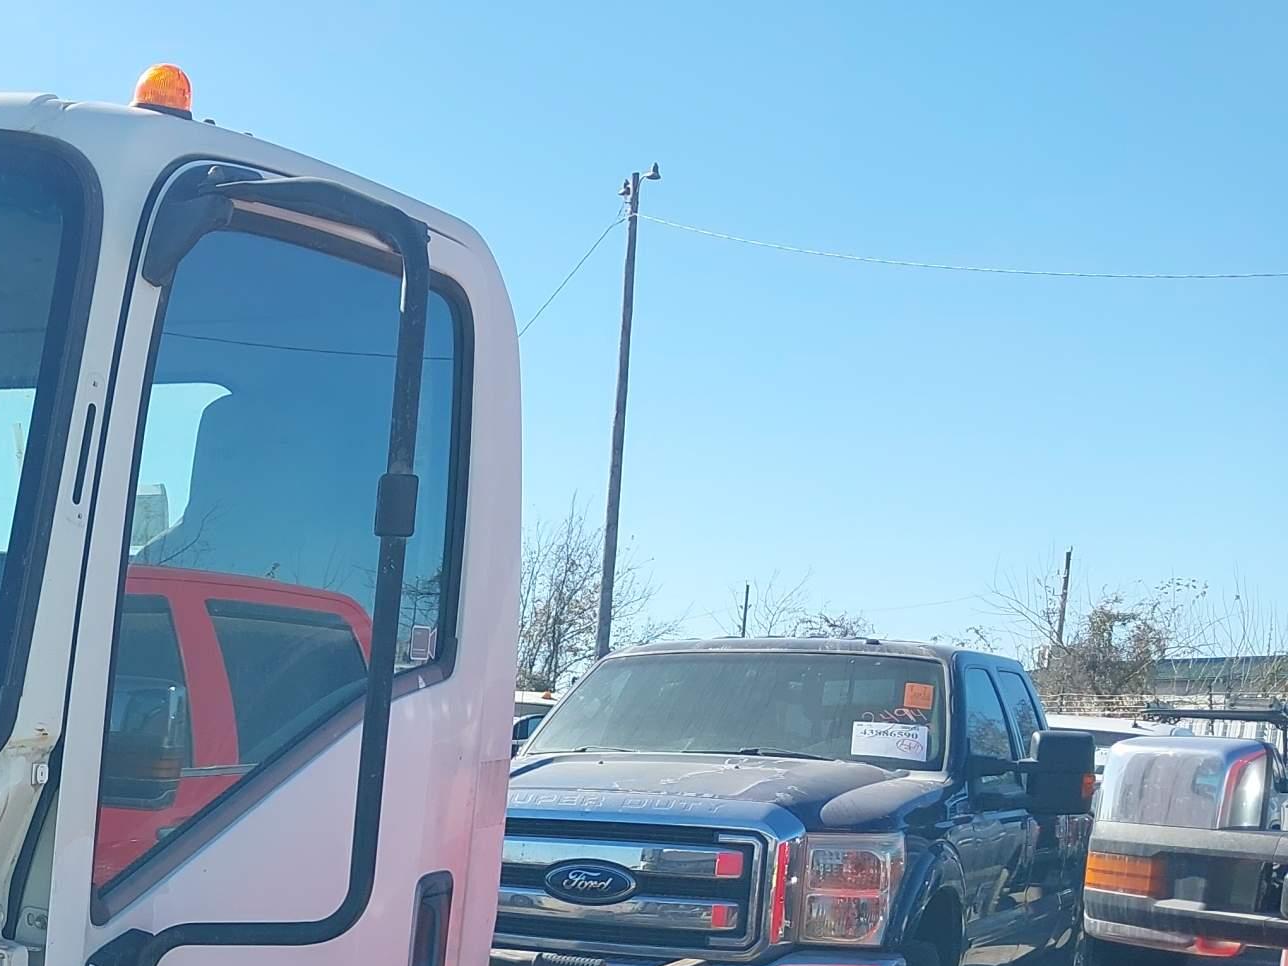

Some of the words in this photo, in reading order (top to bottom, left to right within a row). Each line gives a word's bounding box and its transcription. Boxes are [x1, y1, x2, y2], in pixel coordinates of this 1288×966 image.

[509, 791, 605, 808] UPER
[620, 799, 728, 814] DUTY
[563, 868, 613, 890] Ford
